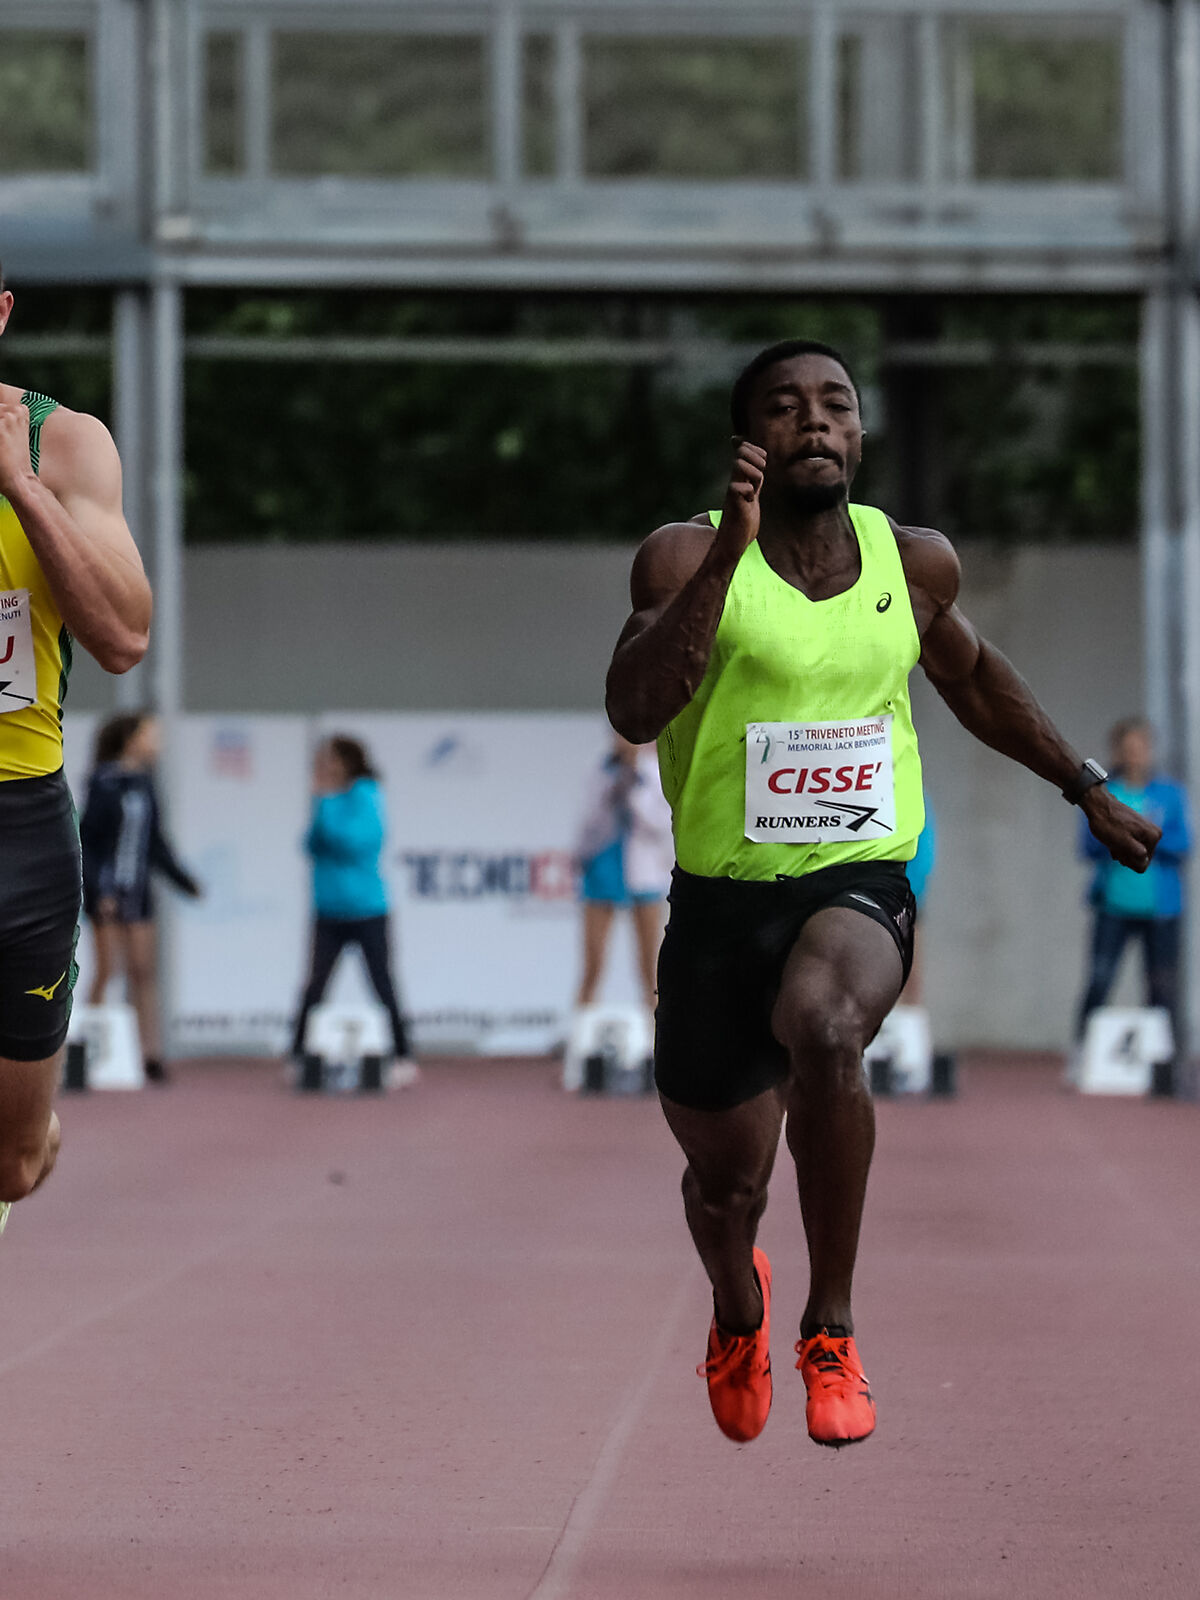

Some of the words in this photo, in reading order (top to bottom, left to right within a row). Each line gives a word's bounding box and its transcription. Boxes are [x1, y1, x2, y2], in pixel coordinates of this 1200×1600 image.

[805, 727, 855, 740] TRIVENETO
[856, 722, 885, 736] MEETING
[787, 743, 833, 752] MEMORIAL
[834, 741, 854, 750] JACK
[854, 737, 886, 749] BENVENUTI
[755, 815, 841, 828] RUNNERS
